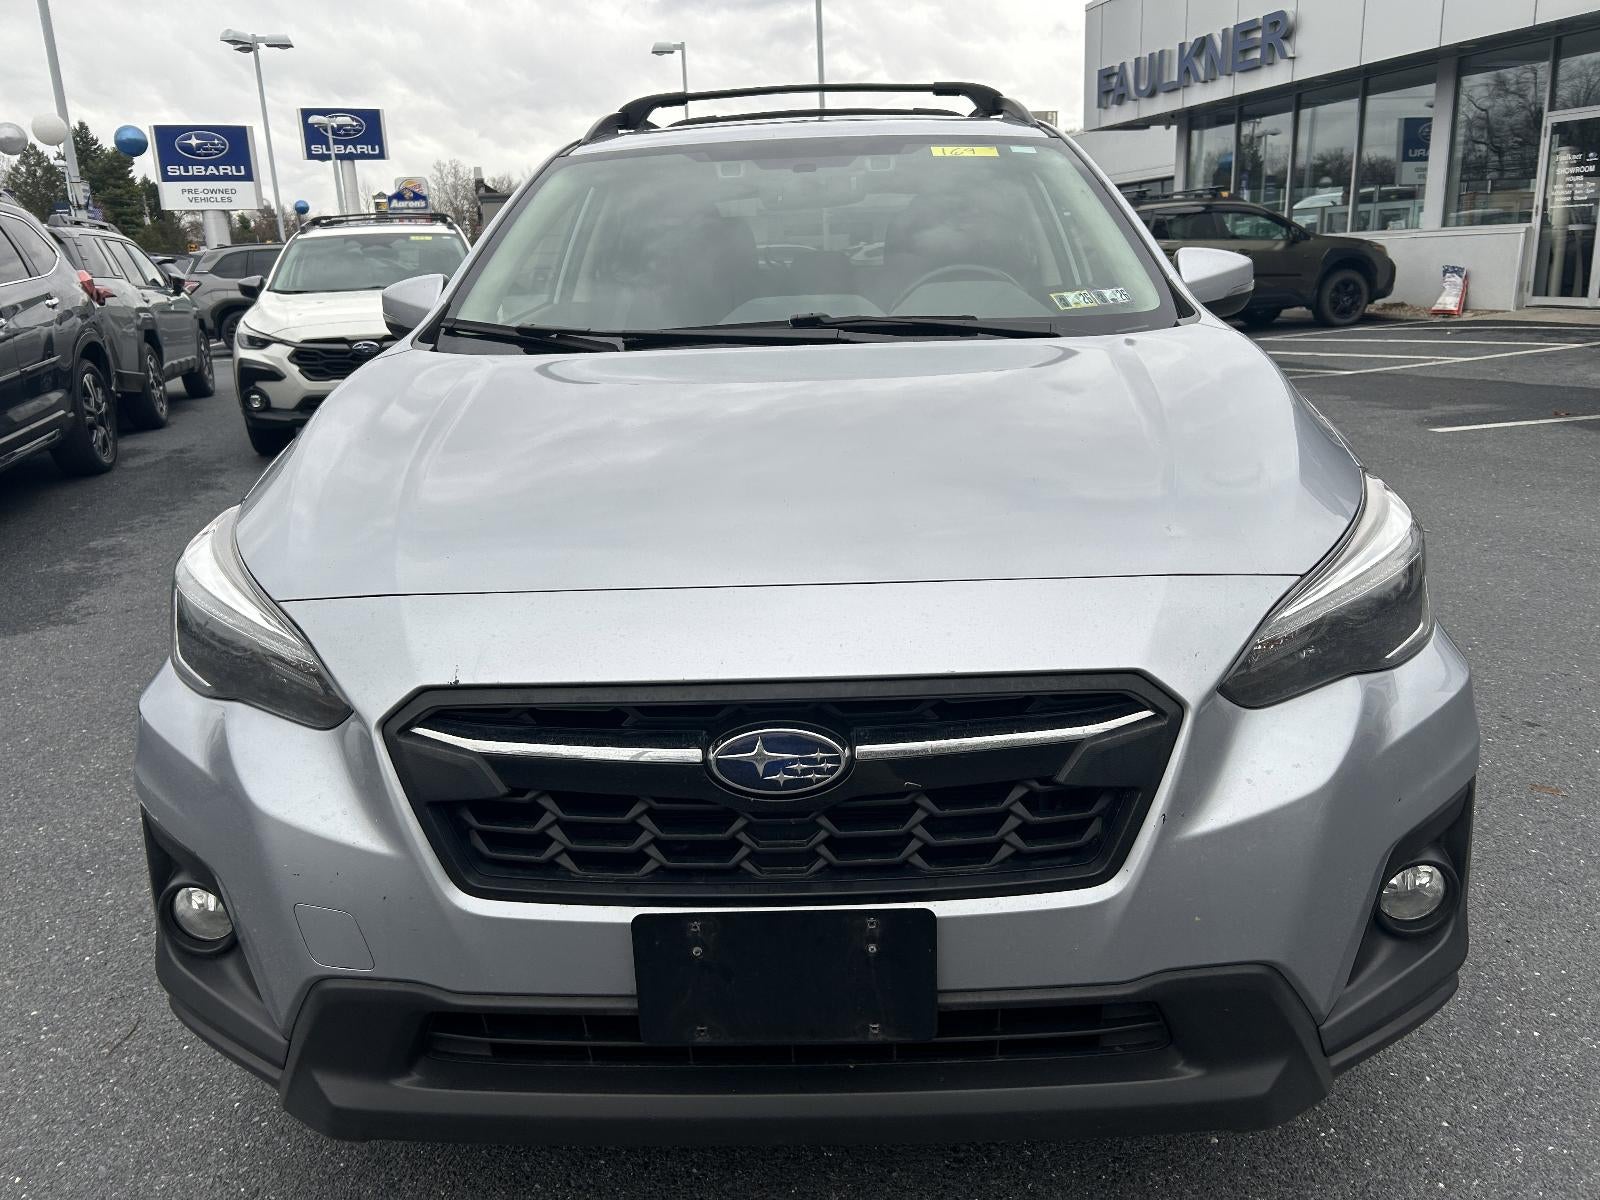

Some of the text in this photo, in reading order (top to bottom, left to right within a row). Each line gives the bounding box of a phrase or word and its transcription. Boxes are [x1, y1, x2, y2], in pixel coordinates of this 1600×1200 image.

[1097, 9, 1297, 109] FAULKNER
[311, 144, 379, 155] SUBARU
[167, 165, 245, 176] SUBARU
[1556, 164, 1596, 175] SHOWROOM
[181, 187, 237, 196] PRE-OWNED
[187, 195, 233, 204] VEHICLES
[390, 199, 426, 208] Aaron's
[1079, 292, 1094, 304] 26
[1115, 289, 1131, 301] 26
